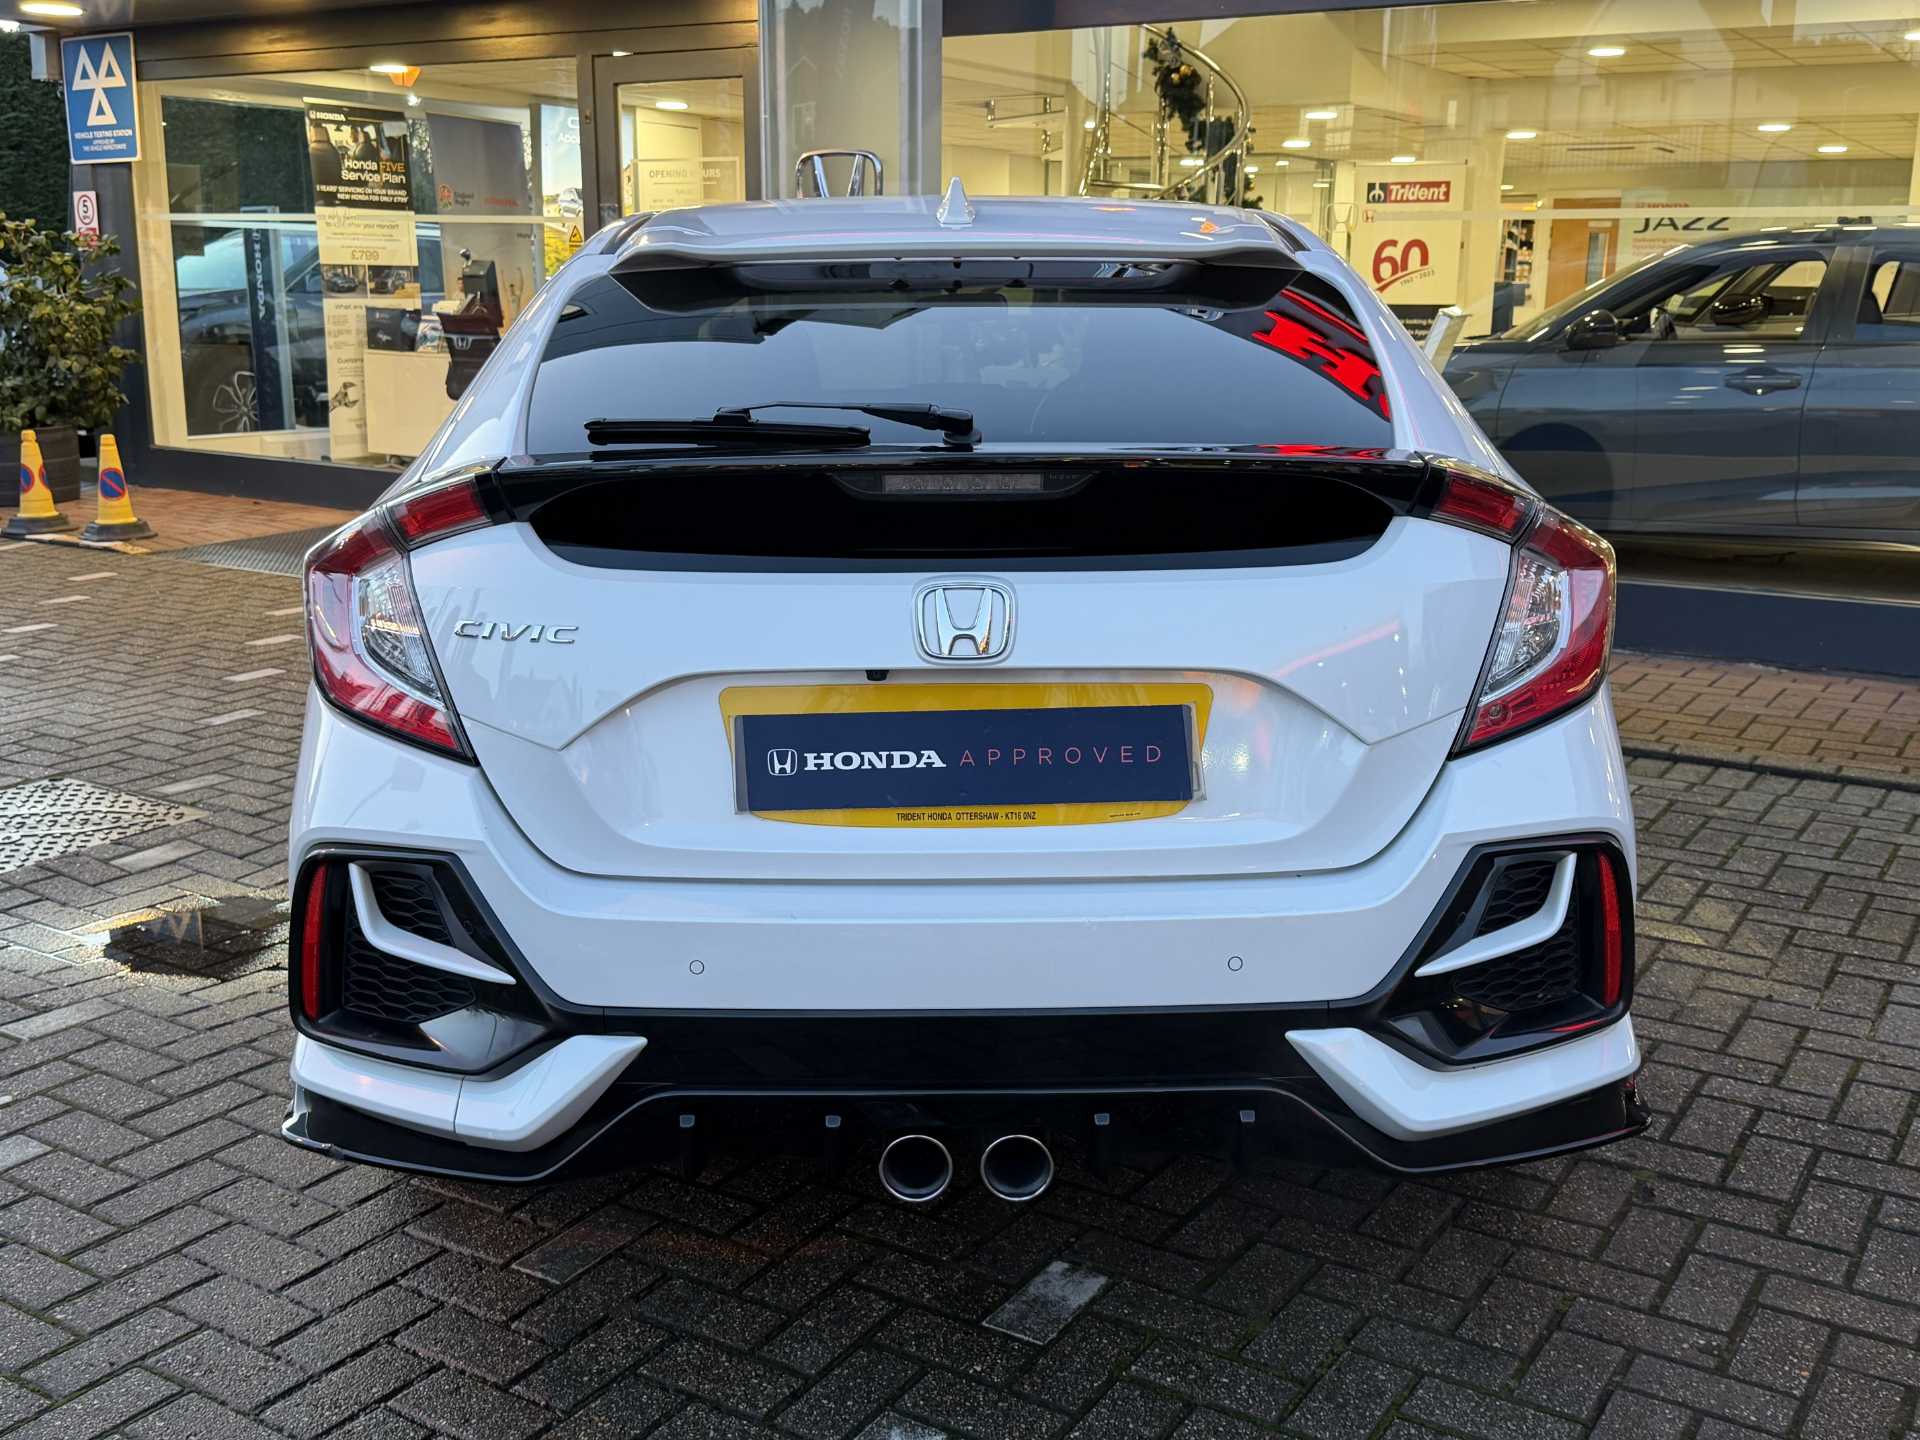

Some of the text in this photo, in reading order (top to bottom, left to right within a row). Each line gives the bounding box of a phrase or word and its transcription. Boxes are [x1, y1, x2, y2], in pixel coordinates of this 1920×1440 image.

[316, 111, 346, 122] HONDA
[343, 159, 406, 173] Honda FIVE
[649, 168, 688, 178] OPENING
[341, 169, 406, 184] Service Plan
[1389, 183, 1448, 201] Trident
[82, 199, 89, 214] 5
[1633, 216, 1731, 234] JAZZ
[1372, 238, 1430, 285] 60
[252, 240, 267, 320] HONDA
[454, 619, 580, 644] CIVIC
[804, 749, 947, 771] HONDA
[959, 745, 1164, 767] APPROVED
[896, 812, 926, 822] TRIDENT
[927, 812, 953, 821] HONDA
[956, 811, 999, 821] OTTERSHAW
[1005, 811, 1022, 821] KT16
